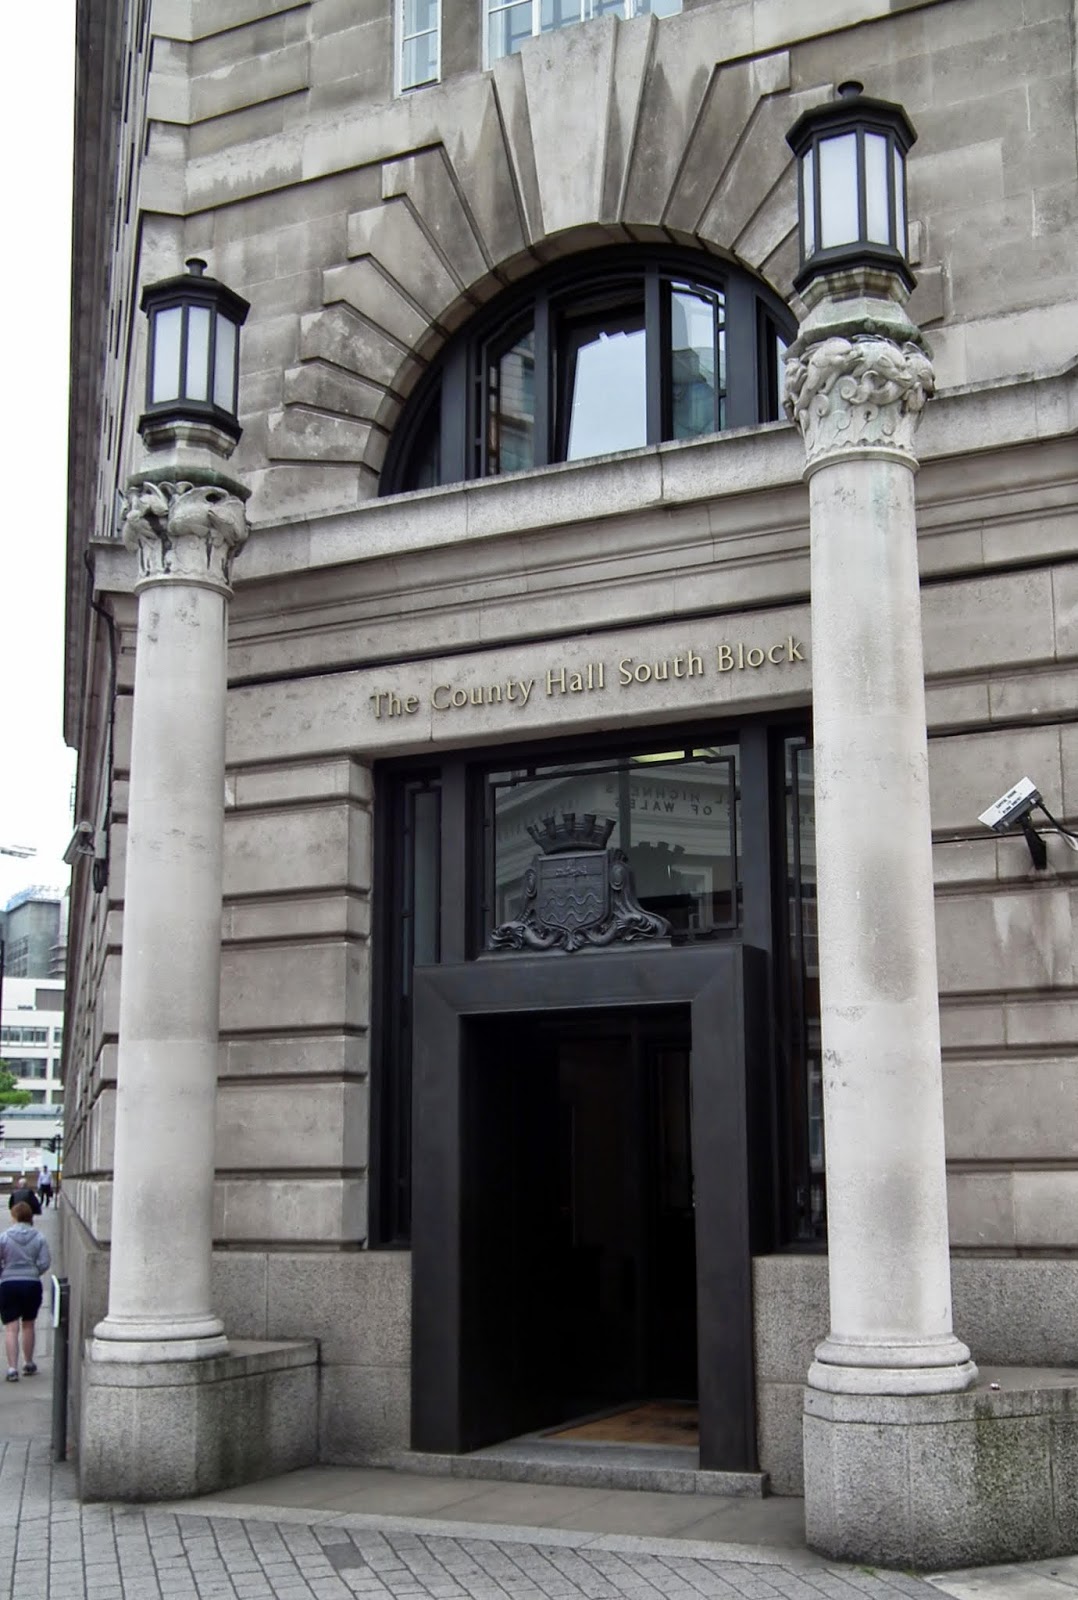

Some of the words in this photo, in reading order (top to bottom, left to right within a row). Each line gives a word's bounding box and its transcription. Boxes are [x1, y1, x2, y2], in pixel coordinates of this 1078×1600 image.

[370, 688, 419, 718] The
[431, 678, 535, 711] County
[545, 662, 606, 697] Hall
[618, 649, 705, 686] South
[716, 635, 806, 673] Block
